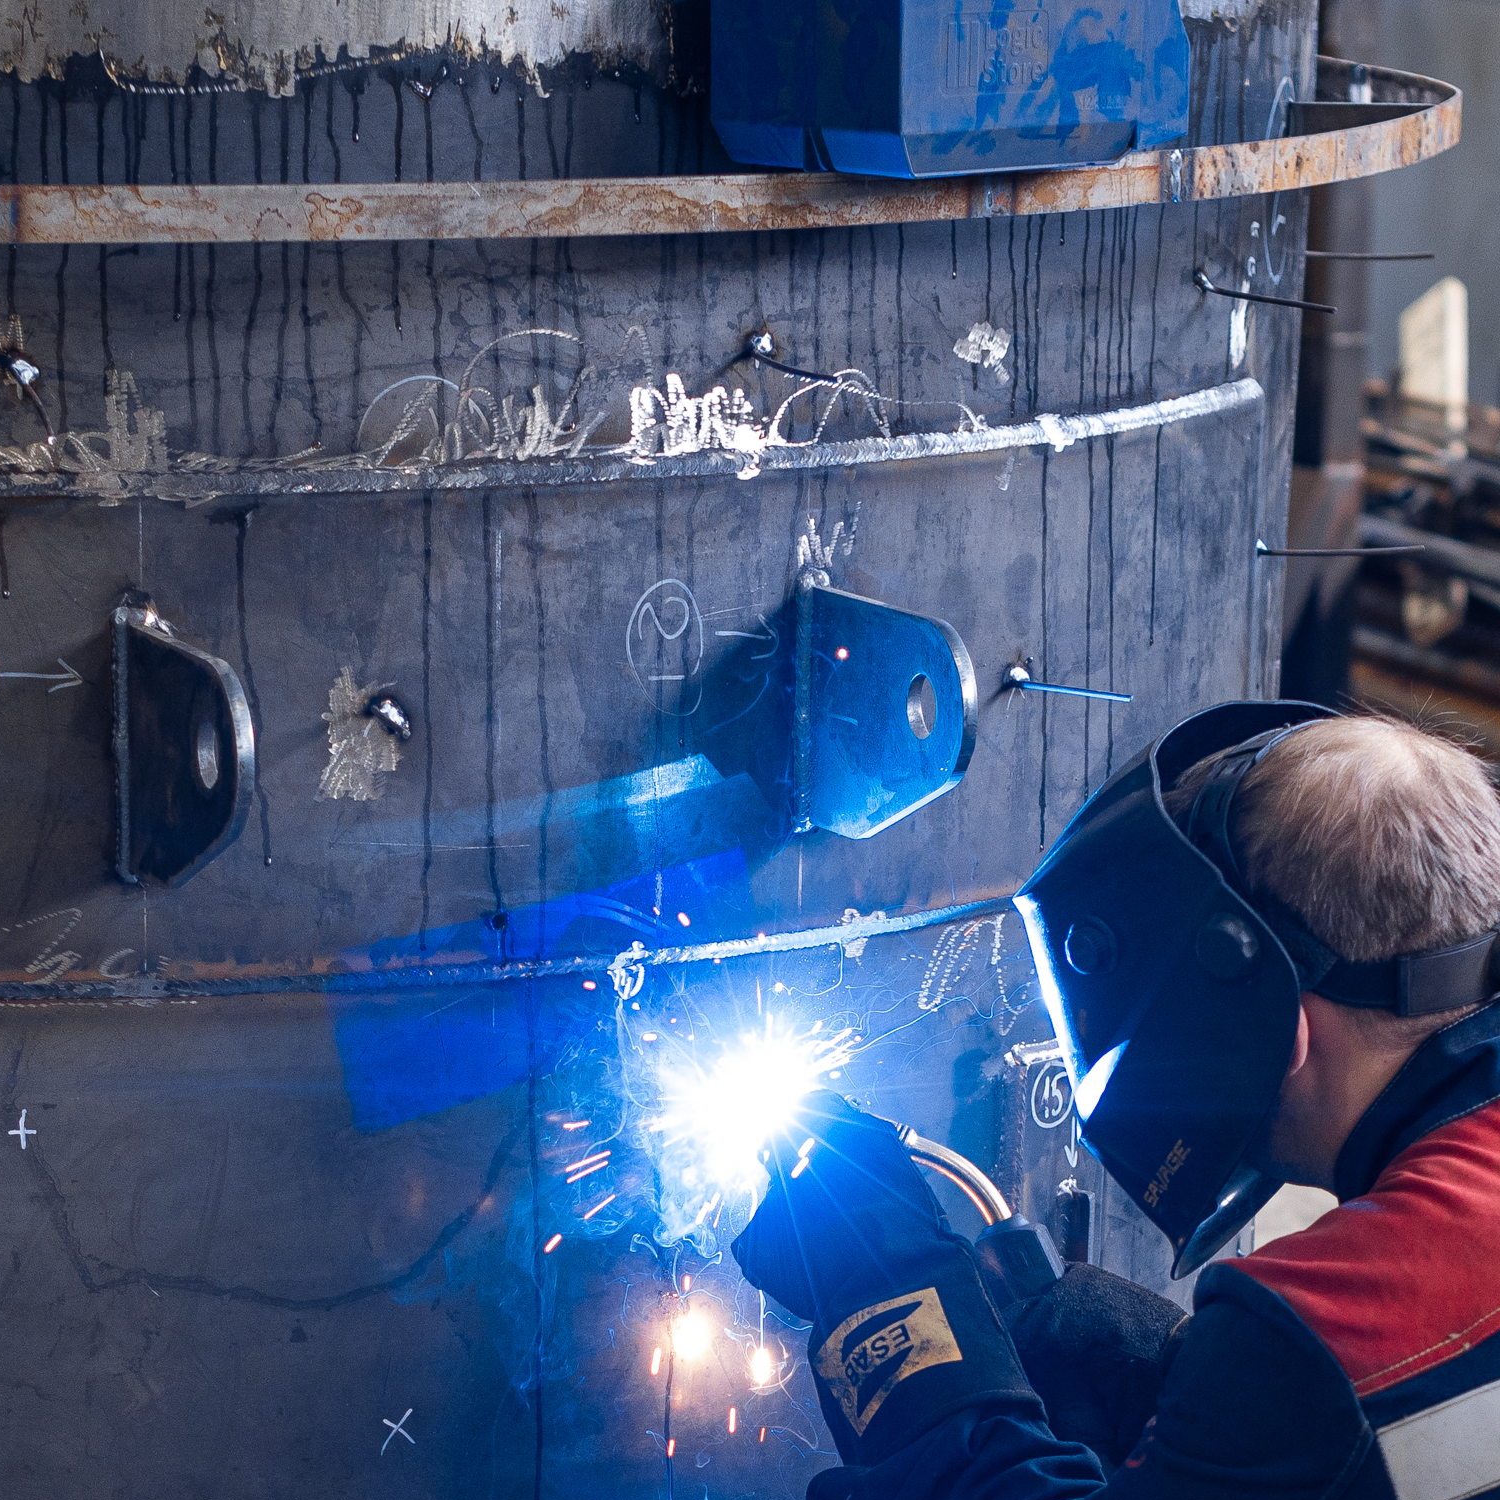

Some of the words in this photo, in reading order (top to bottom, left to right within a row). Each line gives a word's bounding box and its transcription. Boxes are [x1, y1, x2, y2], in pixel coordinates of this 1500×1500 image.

[984, 19, 1045, 58] Logic
[983, 58, 1046, 86] Store
[1040, 1070, 1069, 1119] 15
[1143, 1139, 1191, 1208] SAVAGE
[844, 1323, 911, 1388] ESAB
